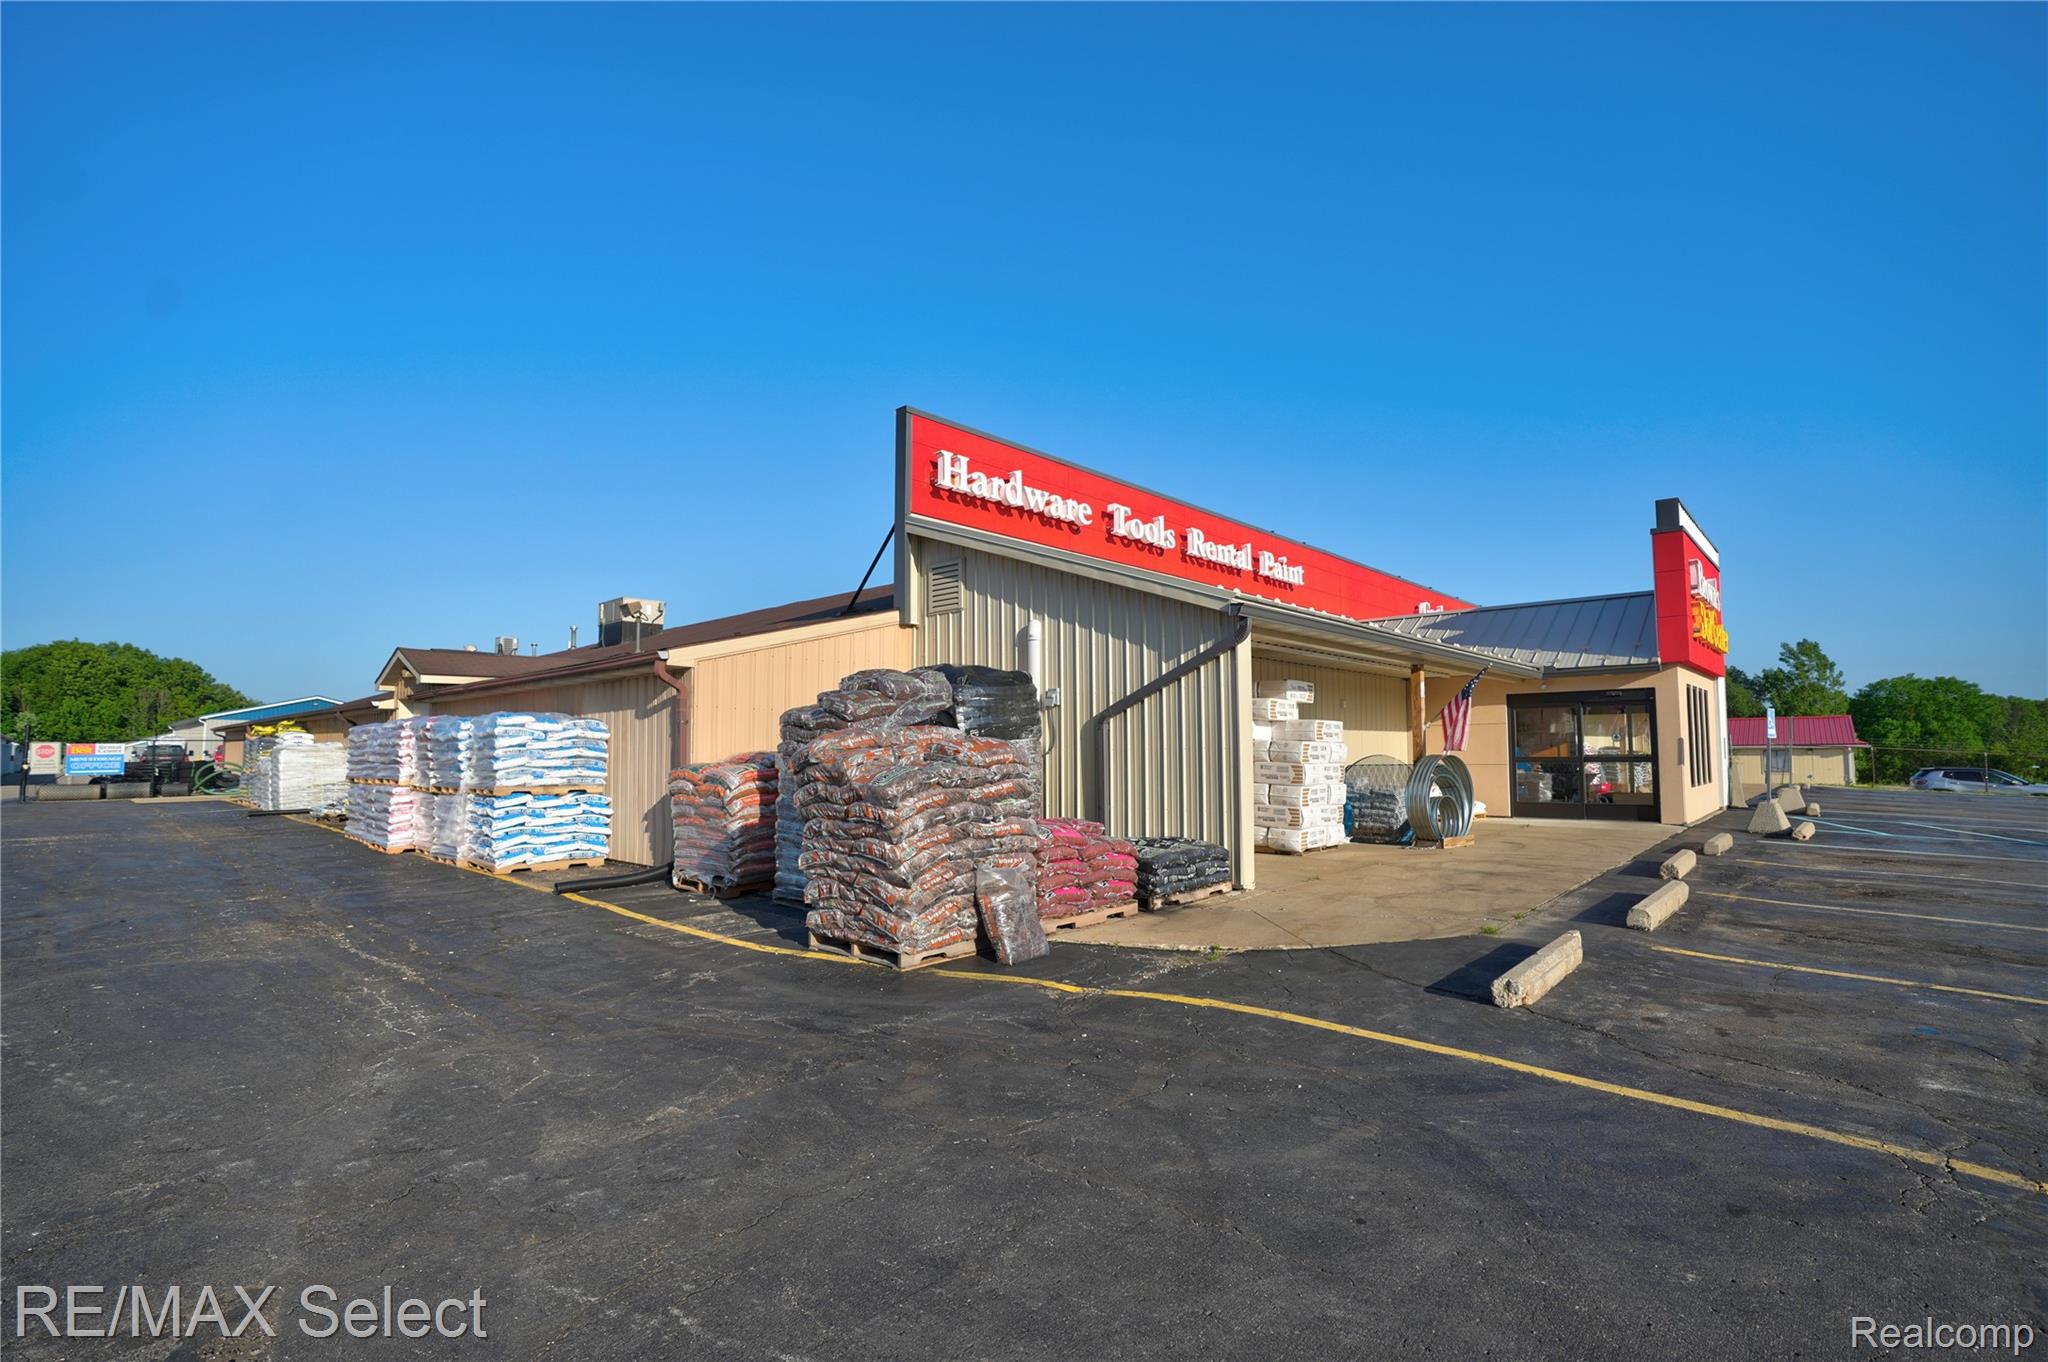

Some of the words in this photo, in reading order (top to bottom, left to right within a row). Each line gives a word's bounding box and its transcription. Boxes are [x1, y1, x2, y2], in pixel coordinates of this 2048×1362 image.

[934, 449, 1093, 526] Hardware
[1107, 502, 1176, 549] Tools
[1186, 527, 1253, 571] Rental
[1258, 550, 1304, 585] Paint
